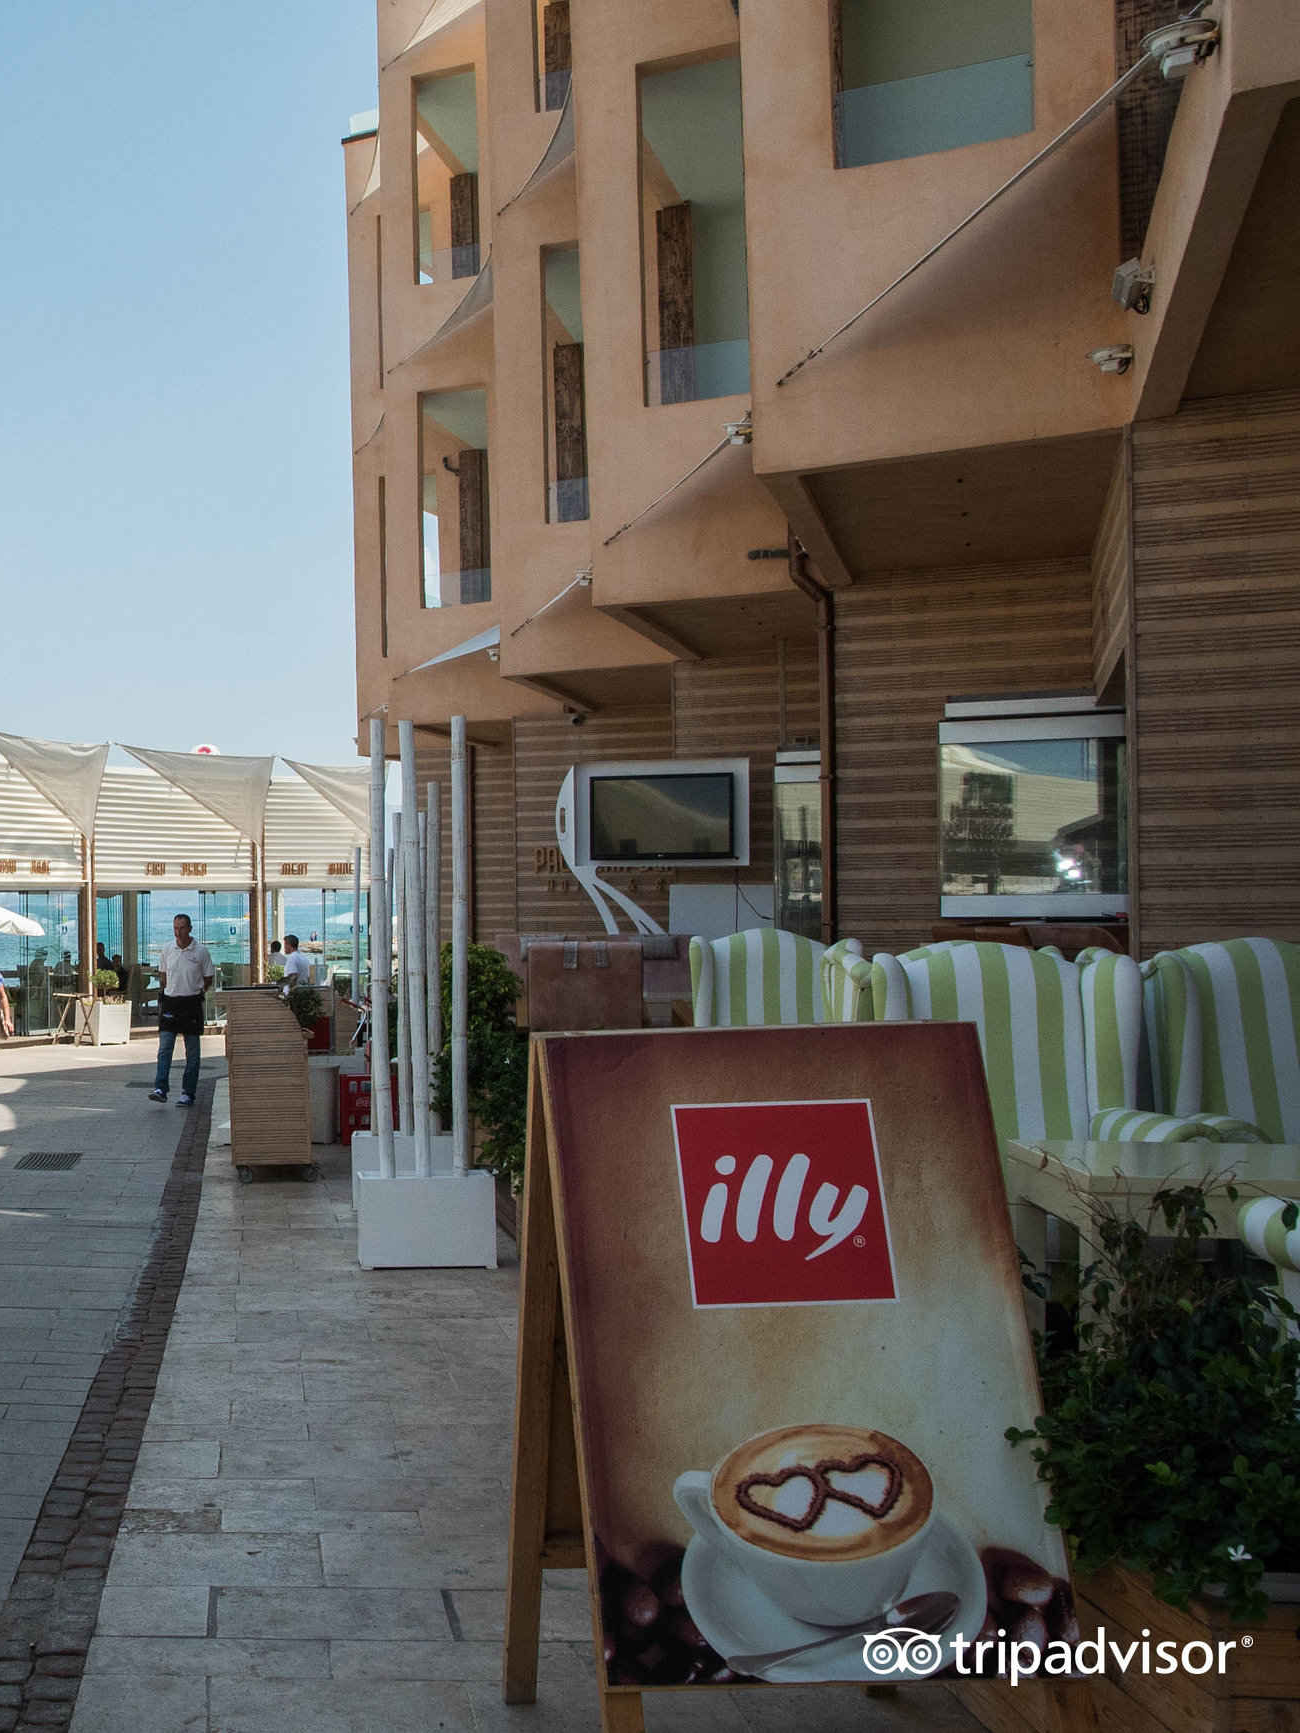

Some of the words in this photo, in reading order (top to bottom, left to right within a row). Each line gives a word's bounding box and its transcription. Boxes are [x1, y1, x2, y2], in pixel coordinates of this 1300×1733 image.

[145, 861, 166, 876] FISH
[281, 862, 310, 876] MEAT
[700, 1153, 870, 1262] illy
